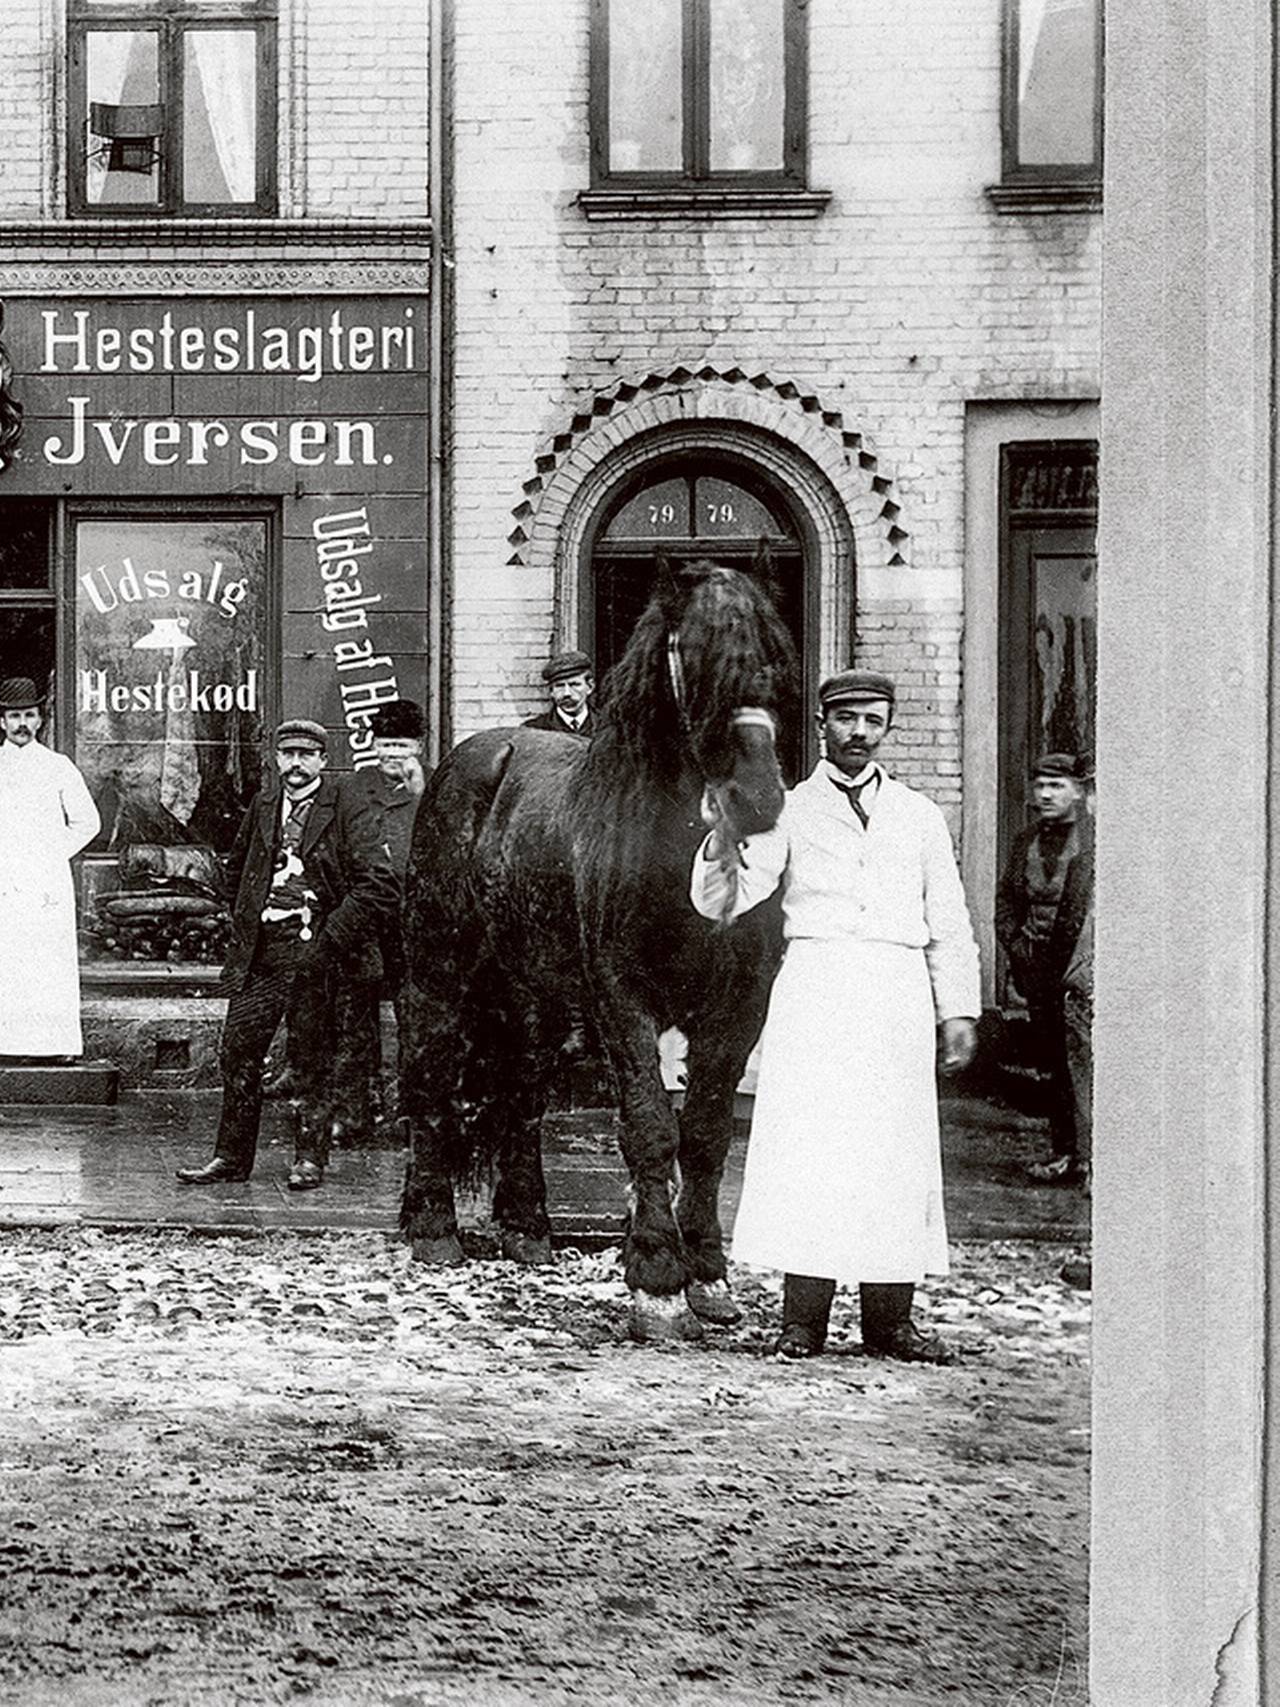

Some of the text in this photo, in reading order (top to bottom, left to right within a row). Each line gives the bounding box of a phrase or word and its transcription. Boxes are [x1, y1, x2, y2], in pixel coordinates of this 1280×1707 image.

[40, 307, 415, 382] Hesteslagteri
[648, 504, 675, 523] 79
[81, 558, 248, 619] Udsalg
[312, 506, 381, 633] Udsalg
[333, 638, 394, 671] af
[80, 669, 257, 714] Hestekød
